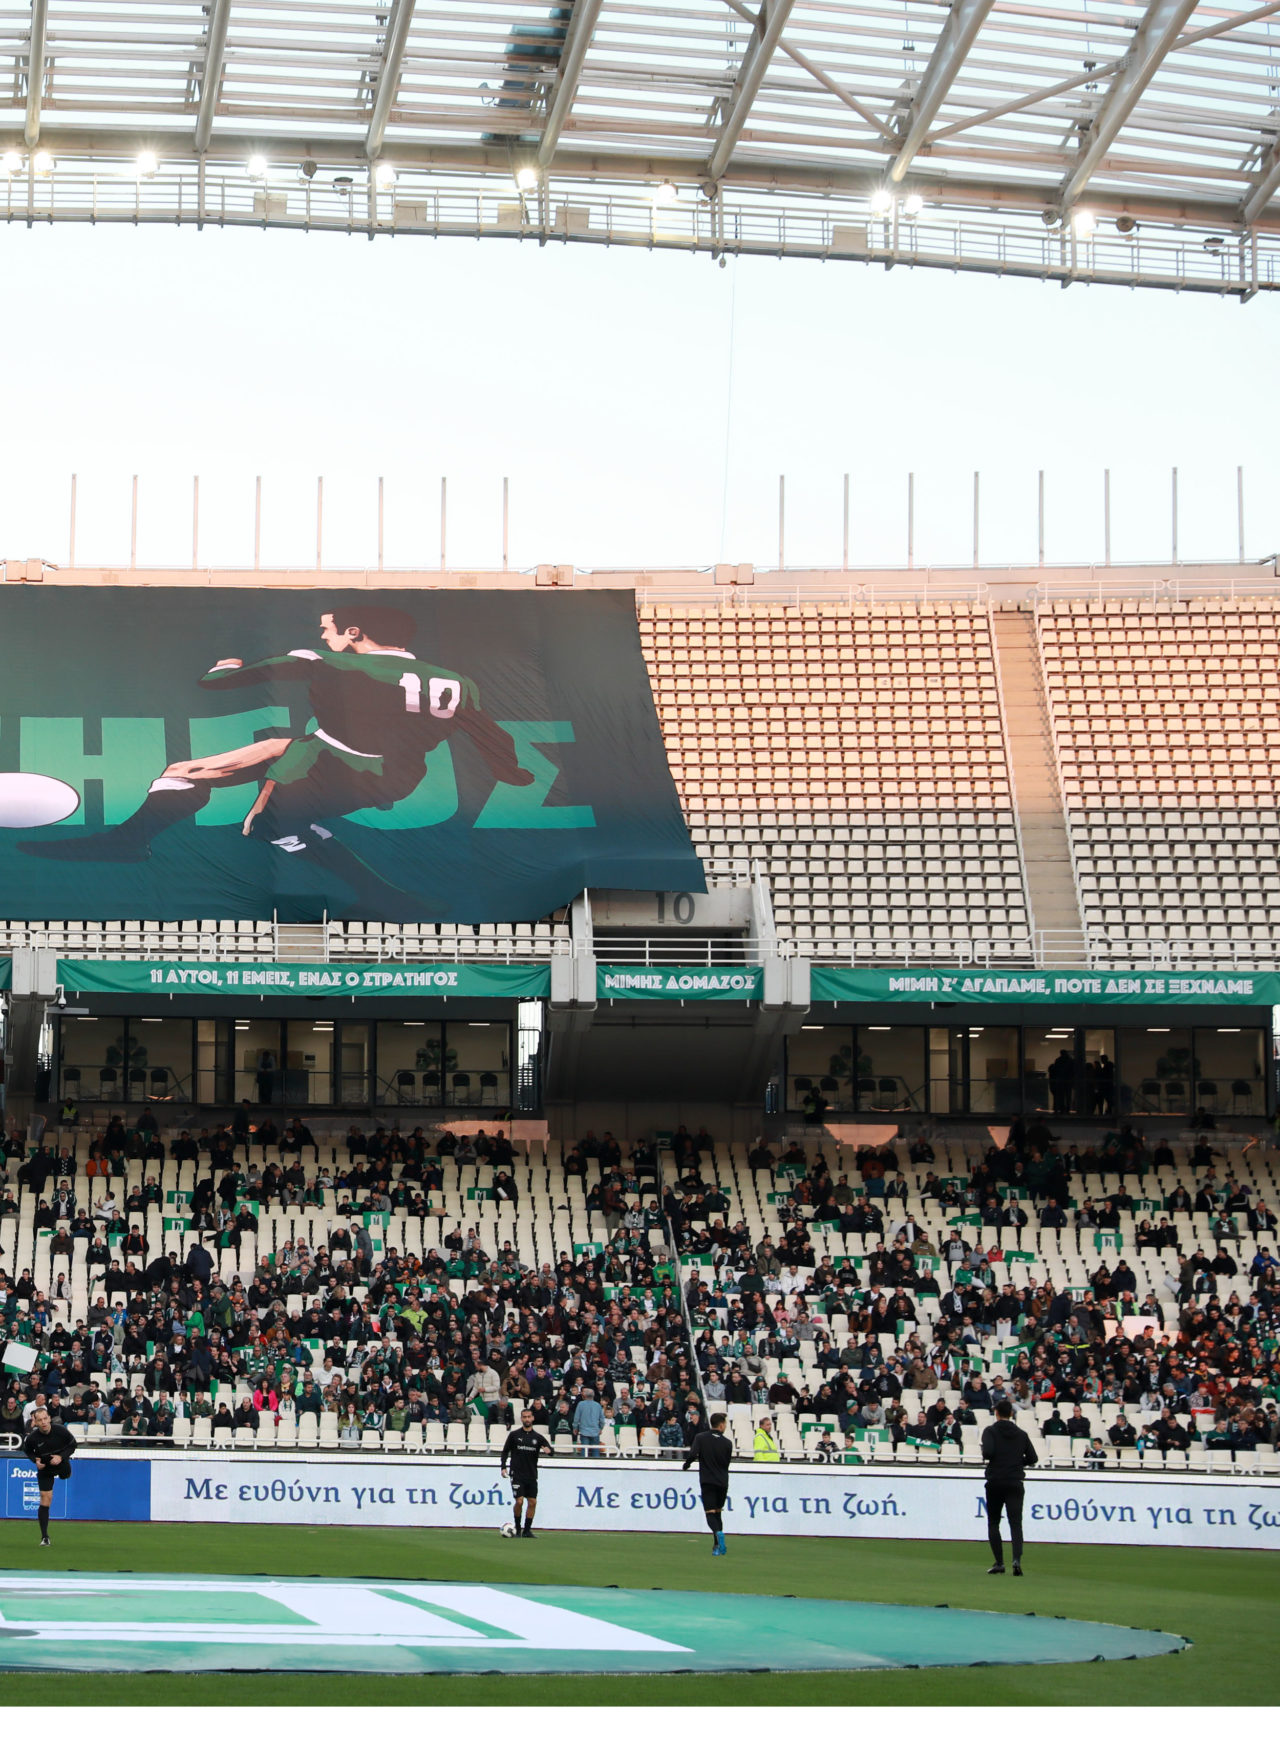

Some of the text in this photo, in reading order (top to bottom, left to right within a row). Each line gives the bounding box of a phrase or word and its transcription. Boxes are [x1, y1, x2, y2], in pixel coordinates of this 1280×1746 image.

[399, 672, 461, 719] 10
[656, 891, 695, 924] 10
[150, 969, 458, 987] 11 ΑΥΤΟΙ, 11 ΕΜΕΙΣ, ΕΝΑΣ Ο ΣΤΡΑΤΗΓΟΣ
[605, 974, 755, 990] ΜΙΜΗΣ ΔΟΜΑΖΟΣ
[889, 977, 938, 991] ΜΙΜΗ
[961, 978, 1051, 995] ΑΓΑΠΑΜΕ,
[1054, 978, 1101, 993] ΠΟΤΕ
[1104, 979, 1141, 993] ΔΕΝ
[1144, 979, 1165, 993] ΣΕ
[1168, 979, 1254, 994] ΞΕΧΝΑΜΕ
[184, 1478, 512, 1510] Με ευθύνη για τη ζωή.
[575, 1486, 619, 1509] Με
[744, 1495, 789, 1519] για
[800, 1498, 831, 1515] τη
[842, 1492, 907, 1520] ζωή.
[1030, 1498, 1136, 1522] ευθύνη
[1147, 1506, 1192, 1529] για
[1202, 1508, 1237, 1526] τη
